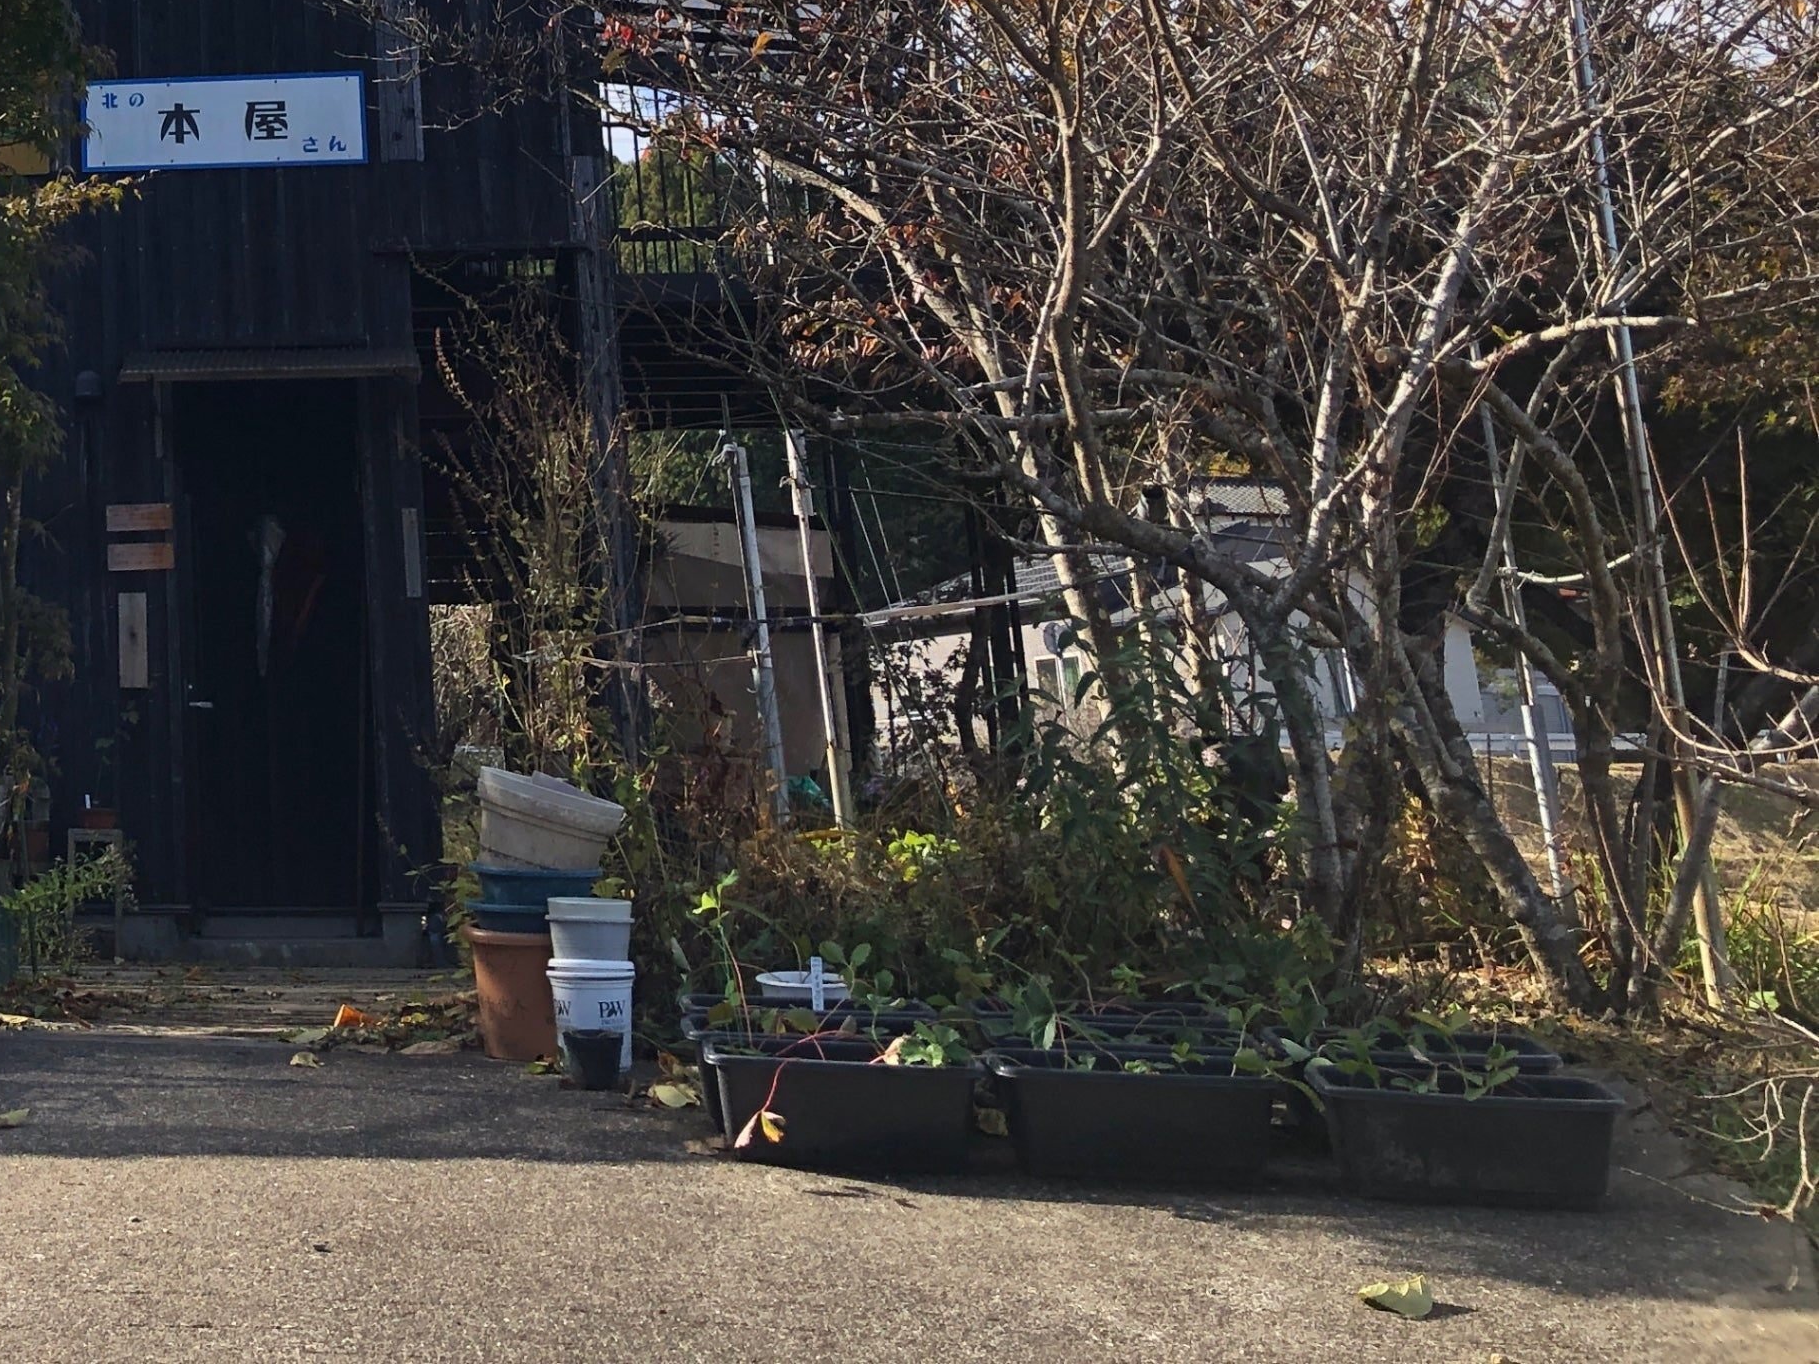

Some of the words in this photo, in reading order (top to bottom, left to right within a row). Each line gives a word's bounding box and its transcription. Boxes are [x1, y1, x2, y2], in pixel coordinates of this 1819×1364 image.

[102, 92, 145, 109] 北の
[157, 100, 289, 144] 本屋
[302, 135, 347, 153] さん
